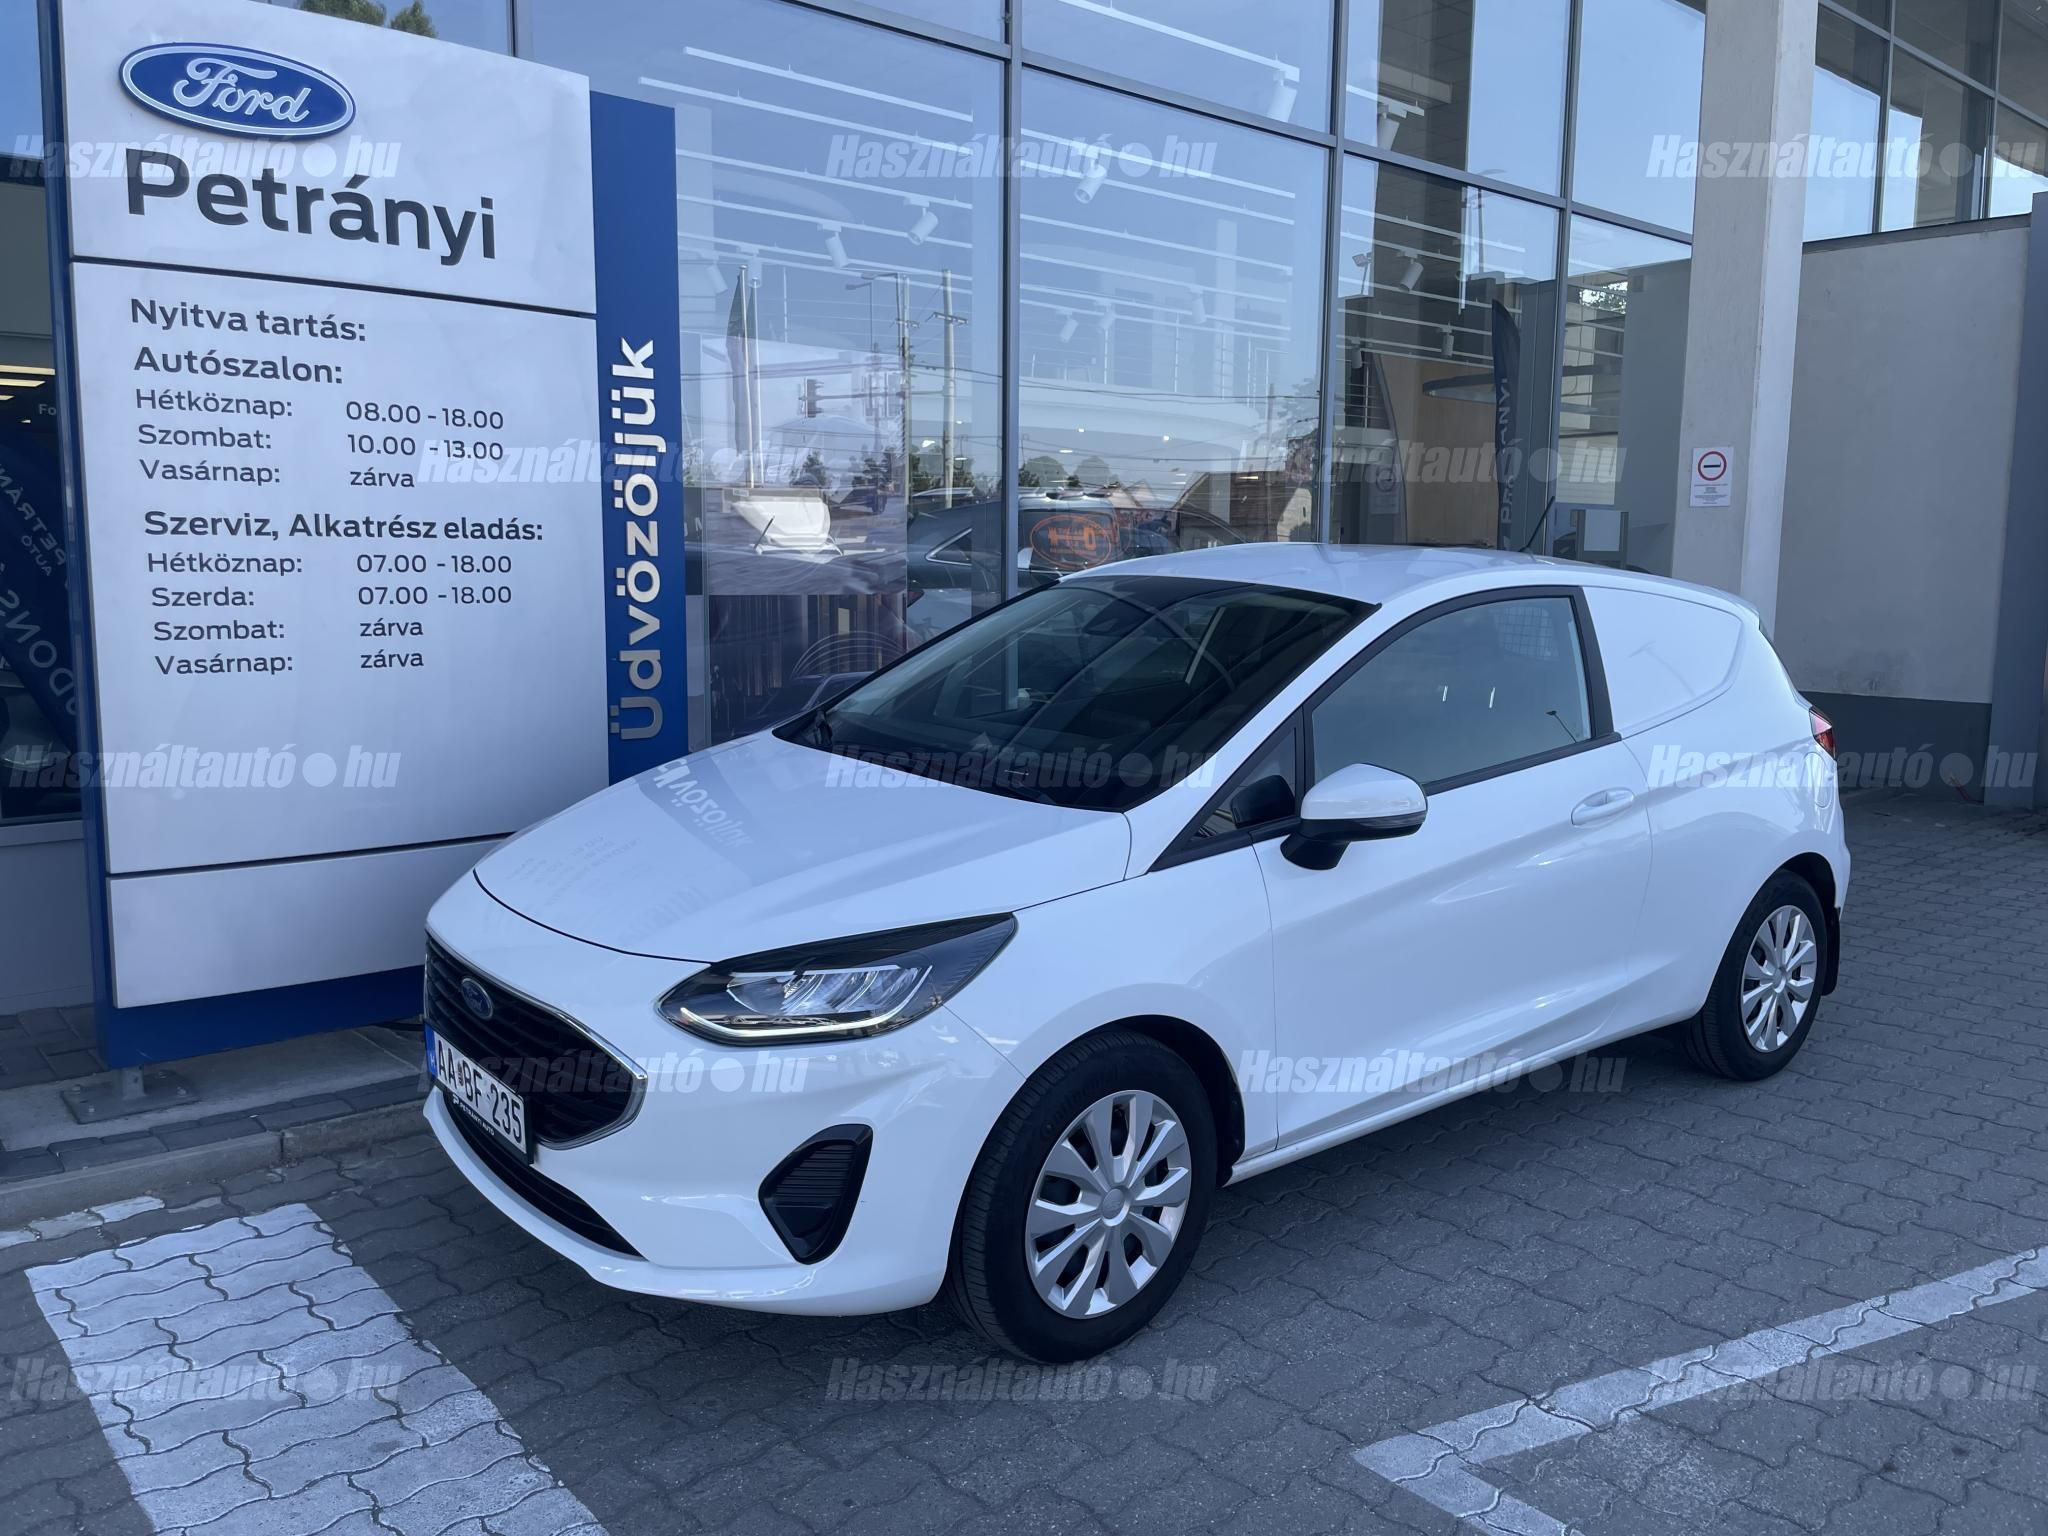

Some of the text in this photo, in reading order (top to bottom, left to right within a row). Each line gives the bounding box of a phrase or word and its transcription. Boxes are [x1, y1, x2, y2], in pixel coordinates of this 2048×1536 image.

[173, 57, 312, 123] Ford
[125, 147, 496, 266] Petrányi
[130, 299, 366, 341] Nyitva tartás:
[134, 347, 343, 384] Autószalon:
[136, 389, 293, 418] Hétköznap:
[346, 401, 421, 423] 08.00
[442, 408, 504, 430] 18.00
[138, 424, 272, 450] Szombat:
[347, 434, 416, 456] 10.00
[443, 440, 504, 460] 13.00
[139, 459, 415, 489] Vasárnap: zárva
[144, 511, 544, 541] Szerviz, Alkatrész eladás:
[610, 337, 667, 740] Üdvözöljük
[147, 553, 303, 576] Hétköznap:
[356, 555, 427, 573] 07.00
[452, 556, 512, 574] 18.00
[151, 587, 254, 607] Szerda:
[358, 587, 428, 605] 07.00
[452, 586, 512, 604] 18.00
[153, 619, 423, 641] Szombat: zárva
[155, 650, 424, 675] Vasárnap: zárva
